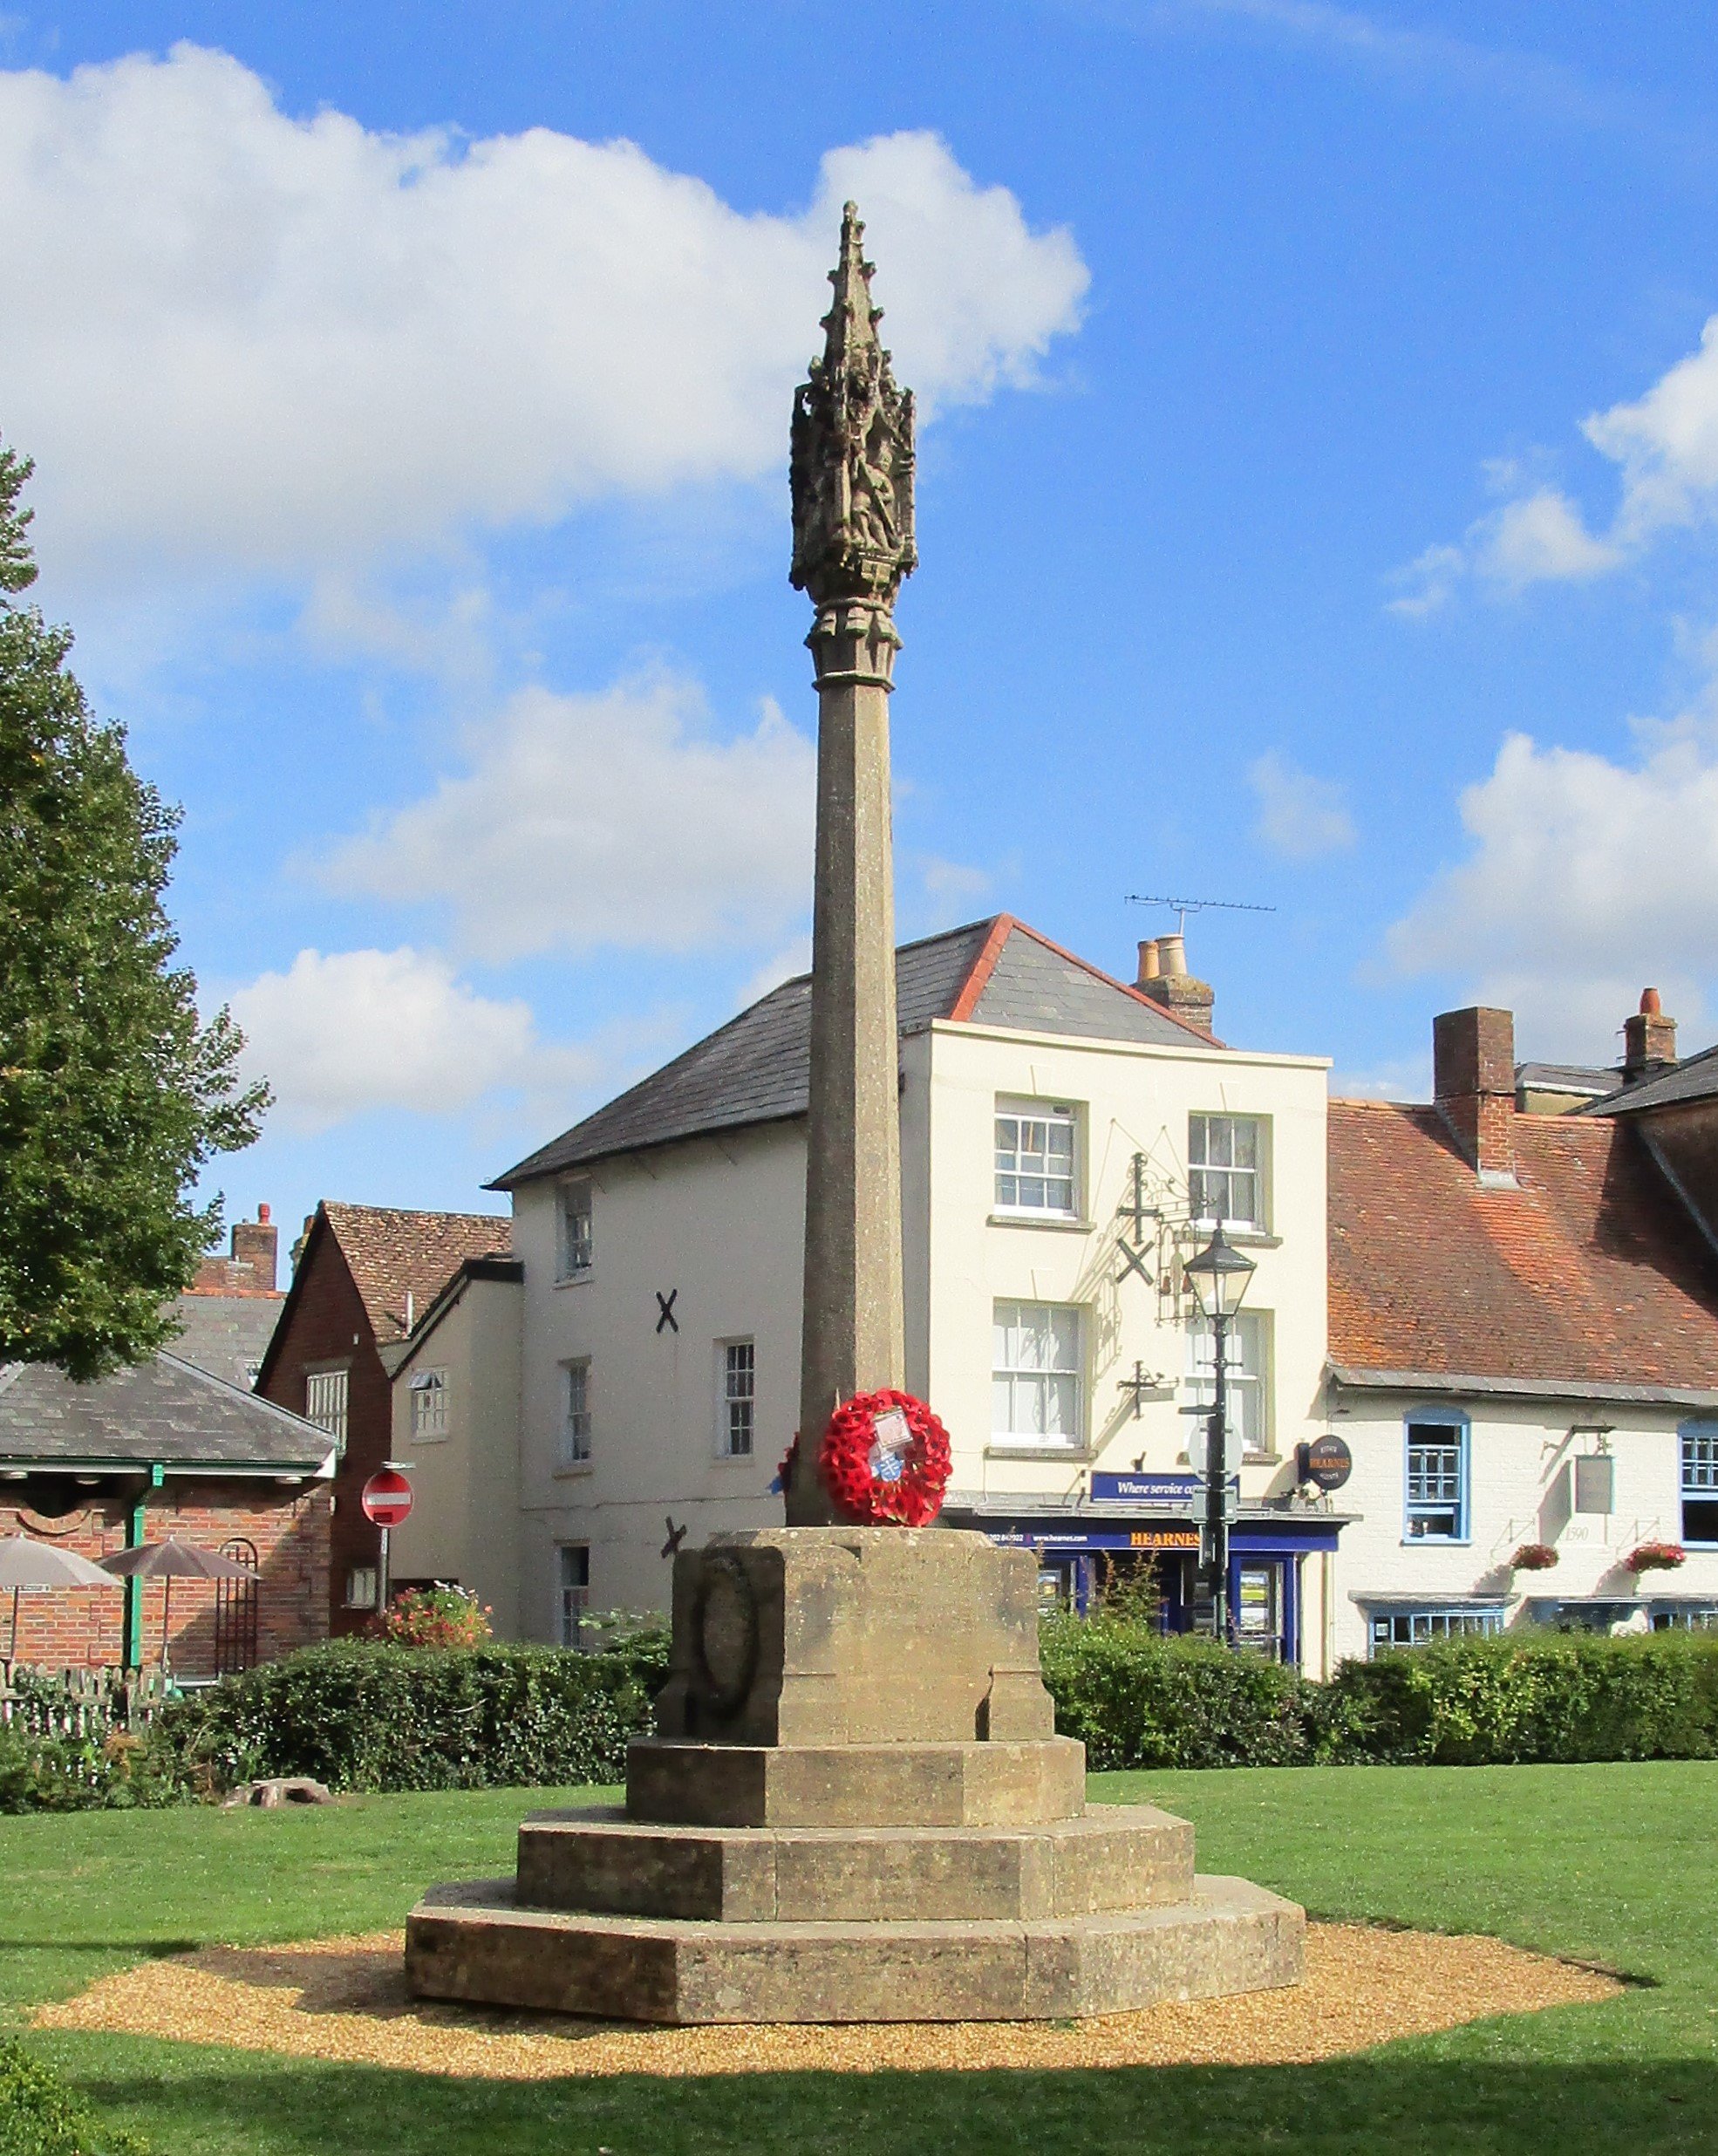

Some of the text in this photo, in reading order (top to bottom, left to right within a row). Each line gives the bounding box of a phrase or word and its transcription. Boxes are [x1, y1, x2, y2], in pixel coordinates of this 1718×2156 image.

[1117, 1481, 1148, 1494] Where
[1149, 1482, 1183, 1495] service
[1130, 1532, 1200, 1546] HEARNES
[1565, 1526, 1589, 1541] 1590
